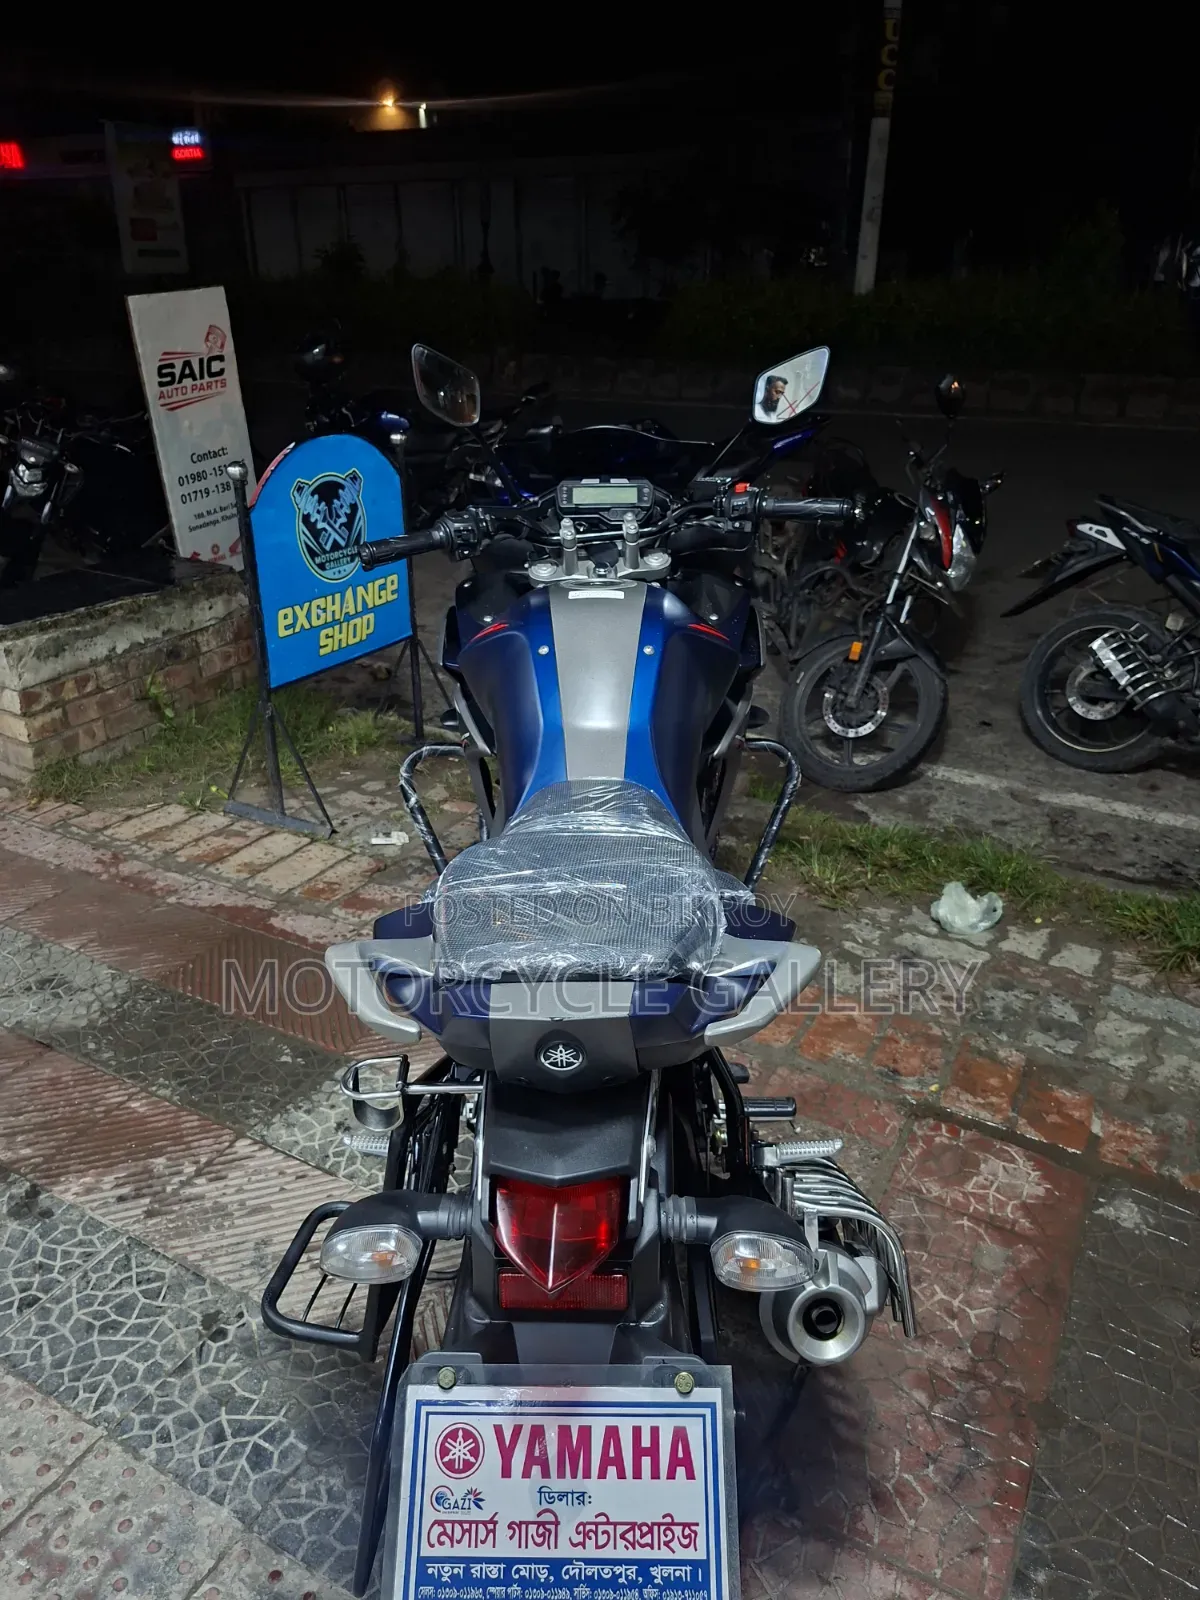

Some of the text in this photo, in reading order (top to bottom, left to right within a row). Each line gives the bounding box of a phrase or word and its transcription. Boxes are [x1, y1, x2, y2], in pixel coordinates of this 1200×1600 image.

[157, 354, 225, 388] SAIC
[158, 379, 227, 400] AUTO PARTS
[190, 446, 229, 464] Contact:
[315, 545, 359, 564] MOTORCYCLE
[325, 557, 352, 570] GALLERY
[319, 612, 375, 657] SHOP
[493, 1424, 697, 1481] YAMAHA
[441, 1497, 472, 1511] GAZI
[427, 1508, 700, 1554] মেসার্স গাজী এন্টারপ্রাইজ
[426, 1563, 466, 1583] নতুন
[470, 1562, 506, 1580] রাস্তা
[561, 1560, 643, 1585] দৌলতপুর,
